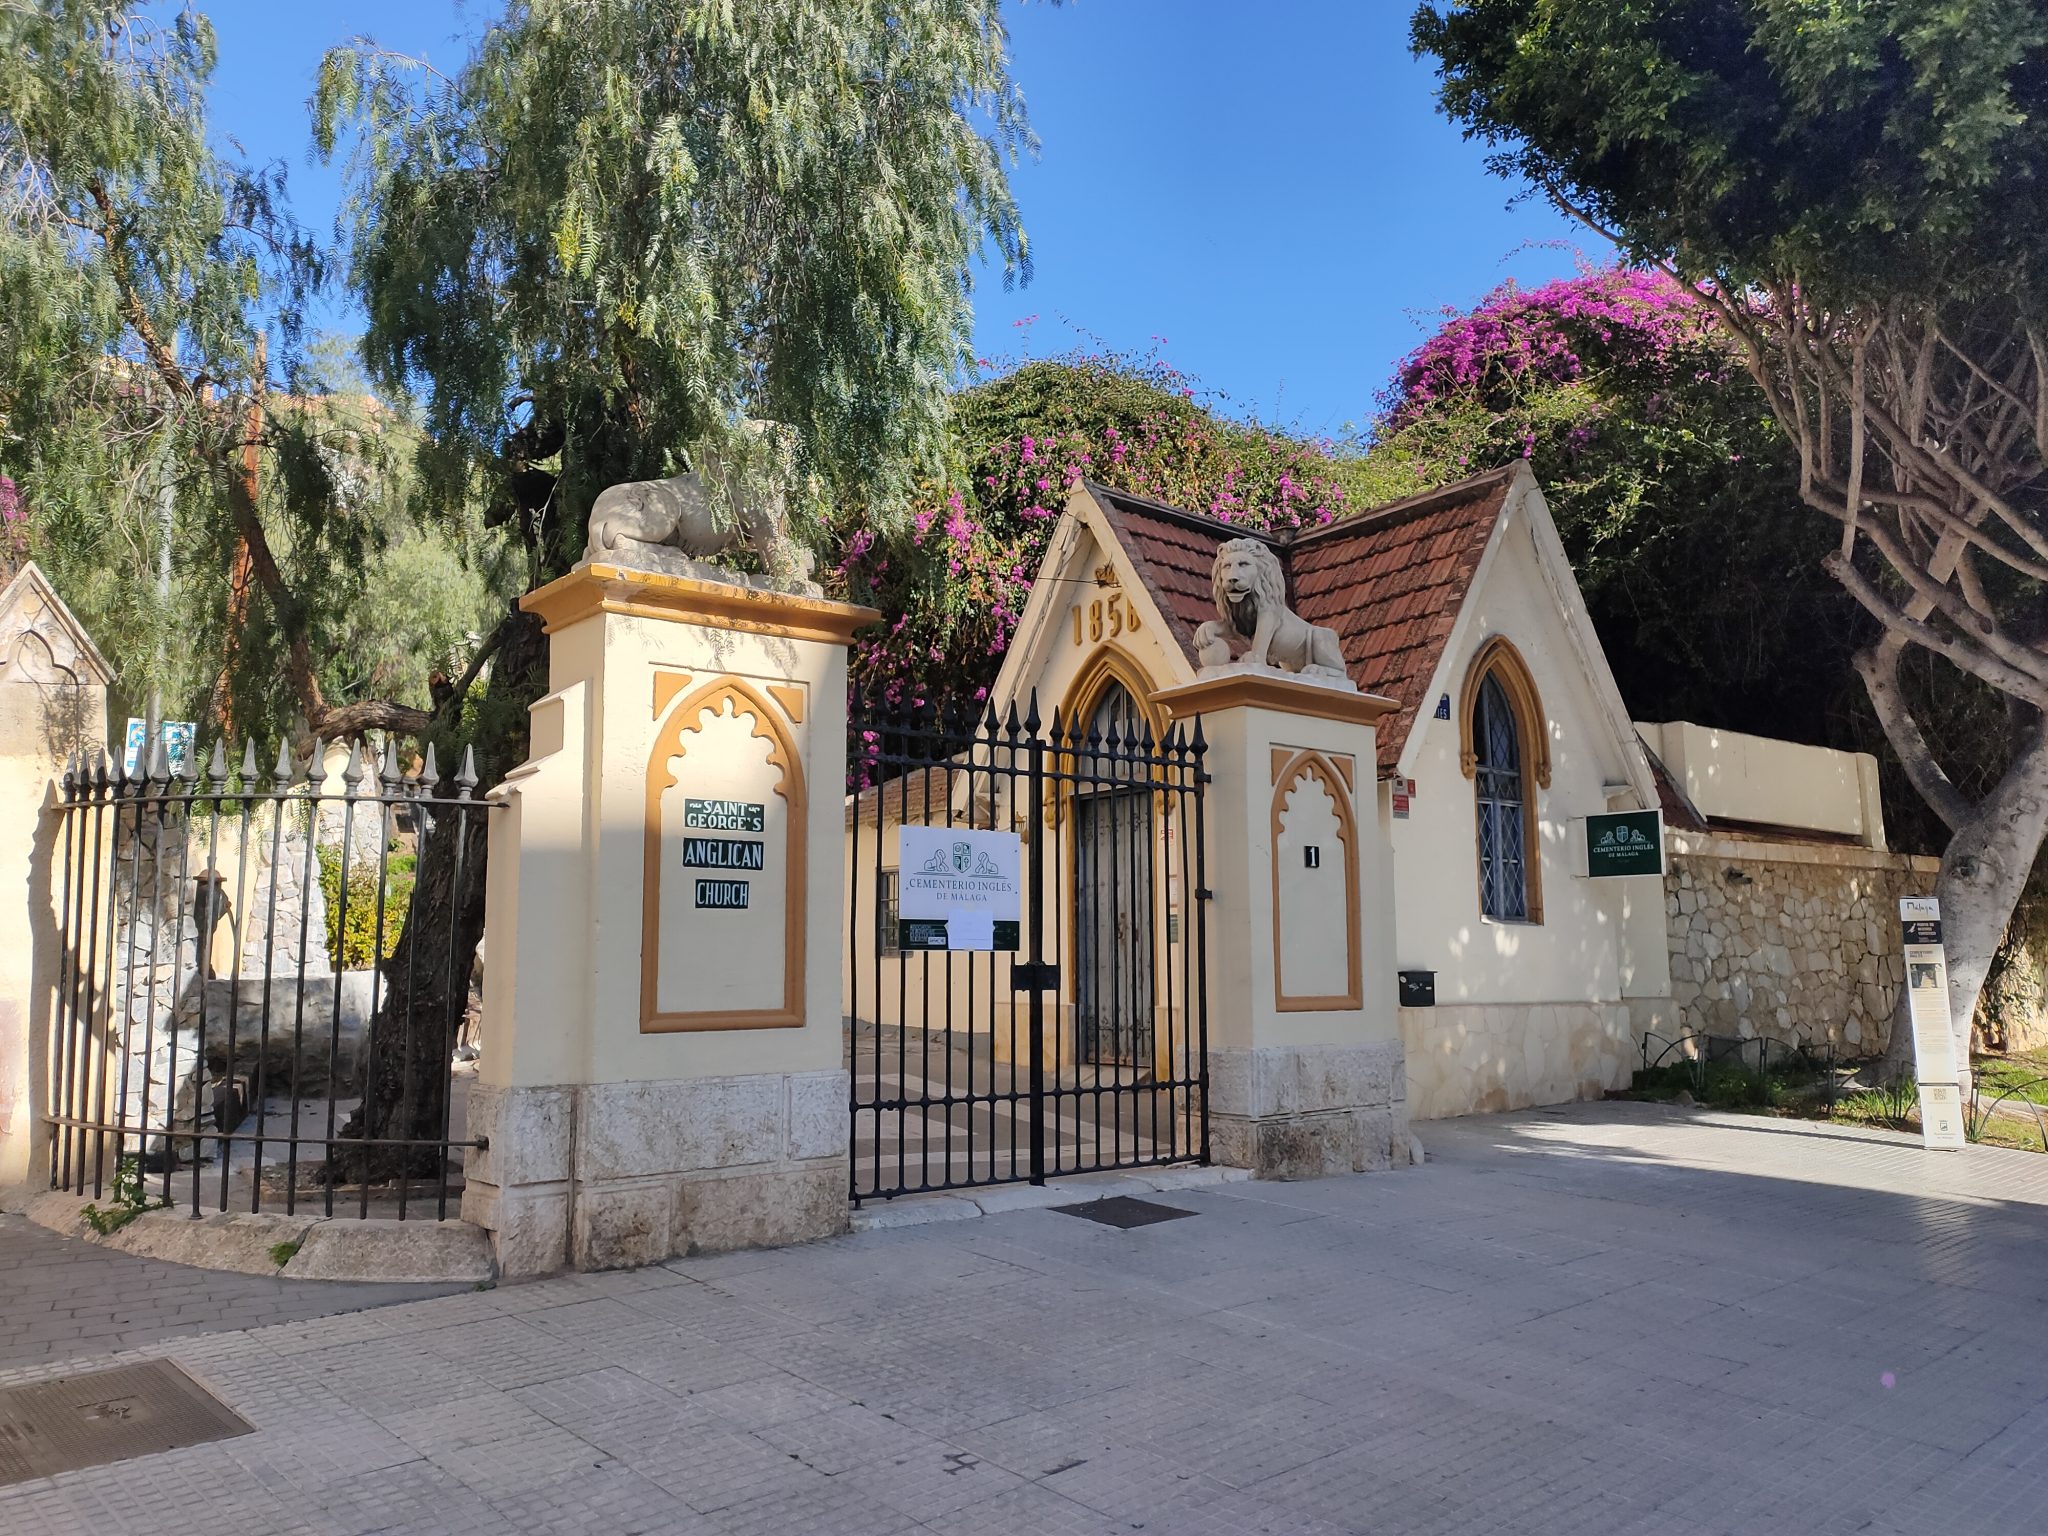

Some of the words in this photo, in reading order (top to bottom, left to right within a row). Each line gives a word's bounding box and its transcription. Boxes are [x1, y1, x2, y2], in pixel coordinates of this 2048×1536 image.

[1072, 593, 1141, 646] 1856
[703, 800, 748, 816] SAINT
[686, 813, 762, 831] GEORGE'S
[684, 841, 762, 868] ANGLICAN
[1309, 846, 1317, 867] 1
[1593, 845, 1631, 853] CEMENTERIO
[697, 881, 748, 906] CHURCH
[909, 878, 976, 891] CEMENTERIO
[936, 892, 947, 900] DE
[950, 891, 987, 901] MÁLAGA
